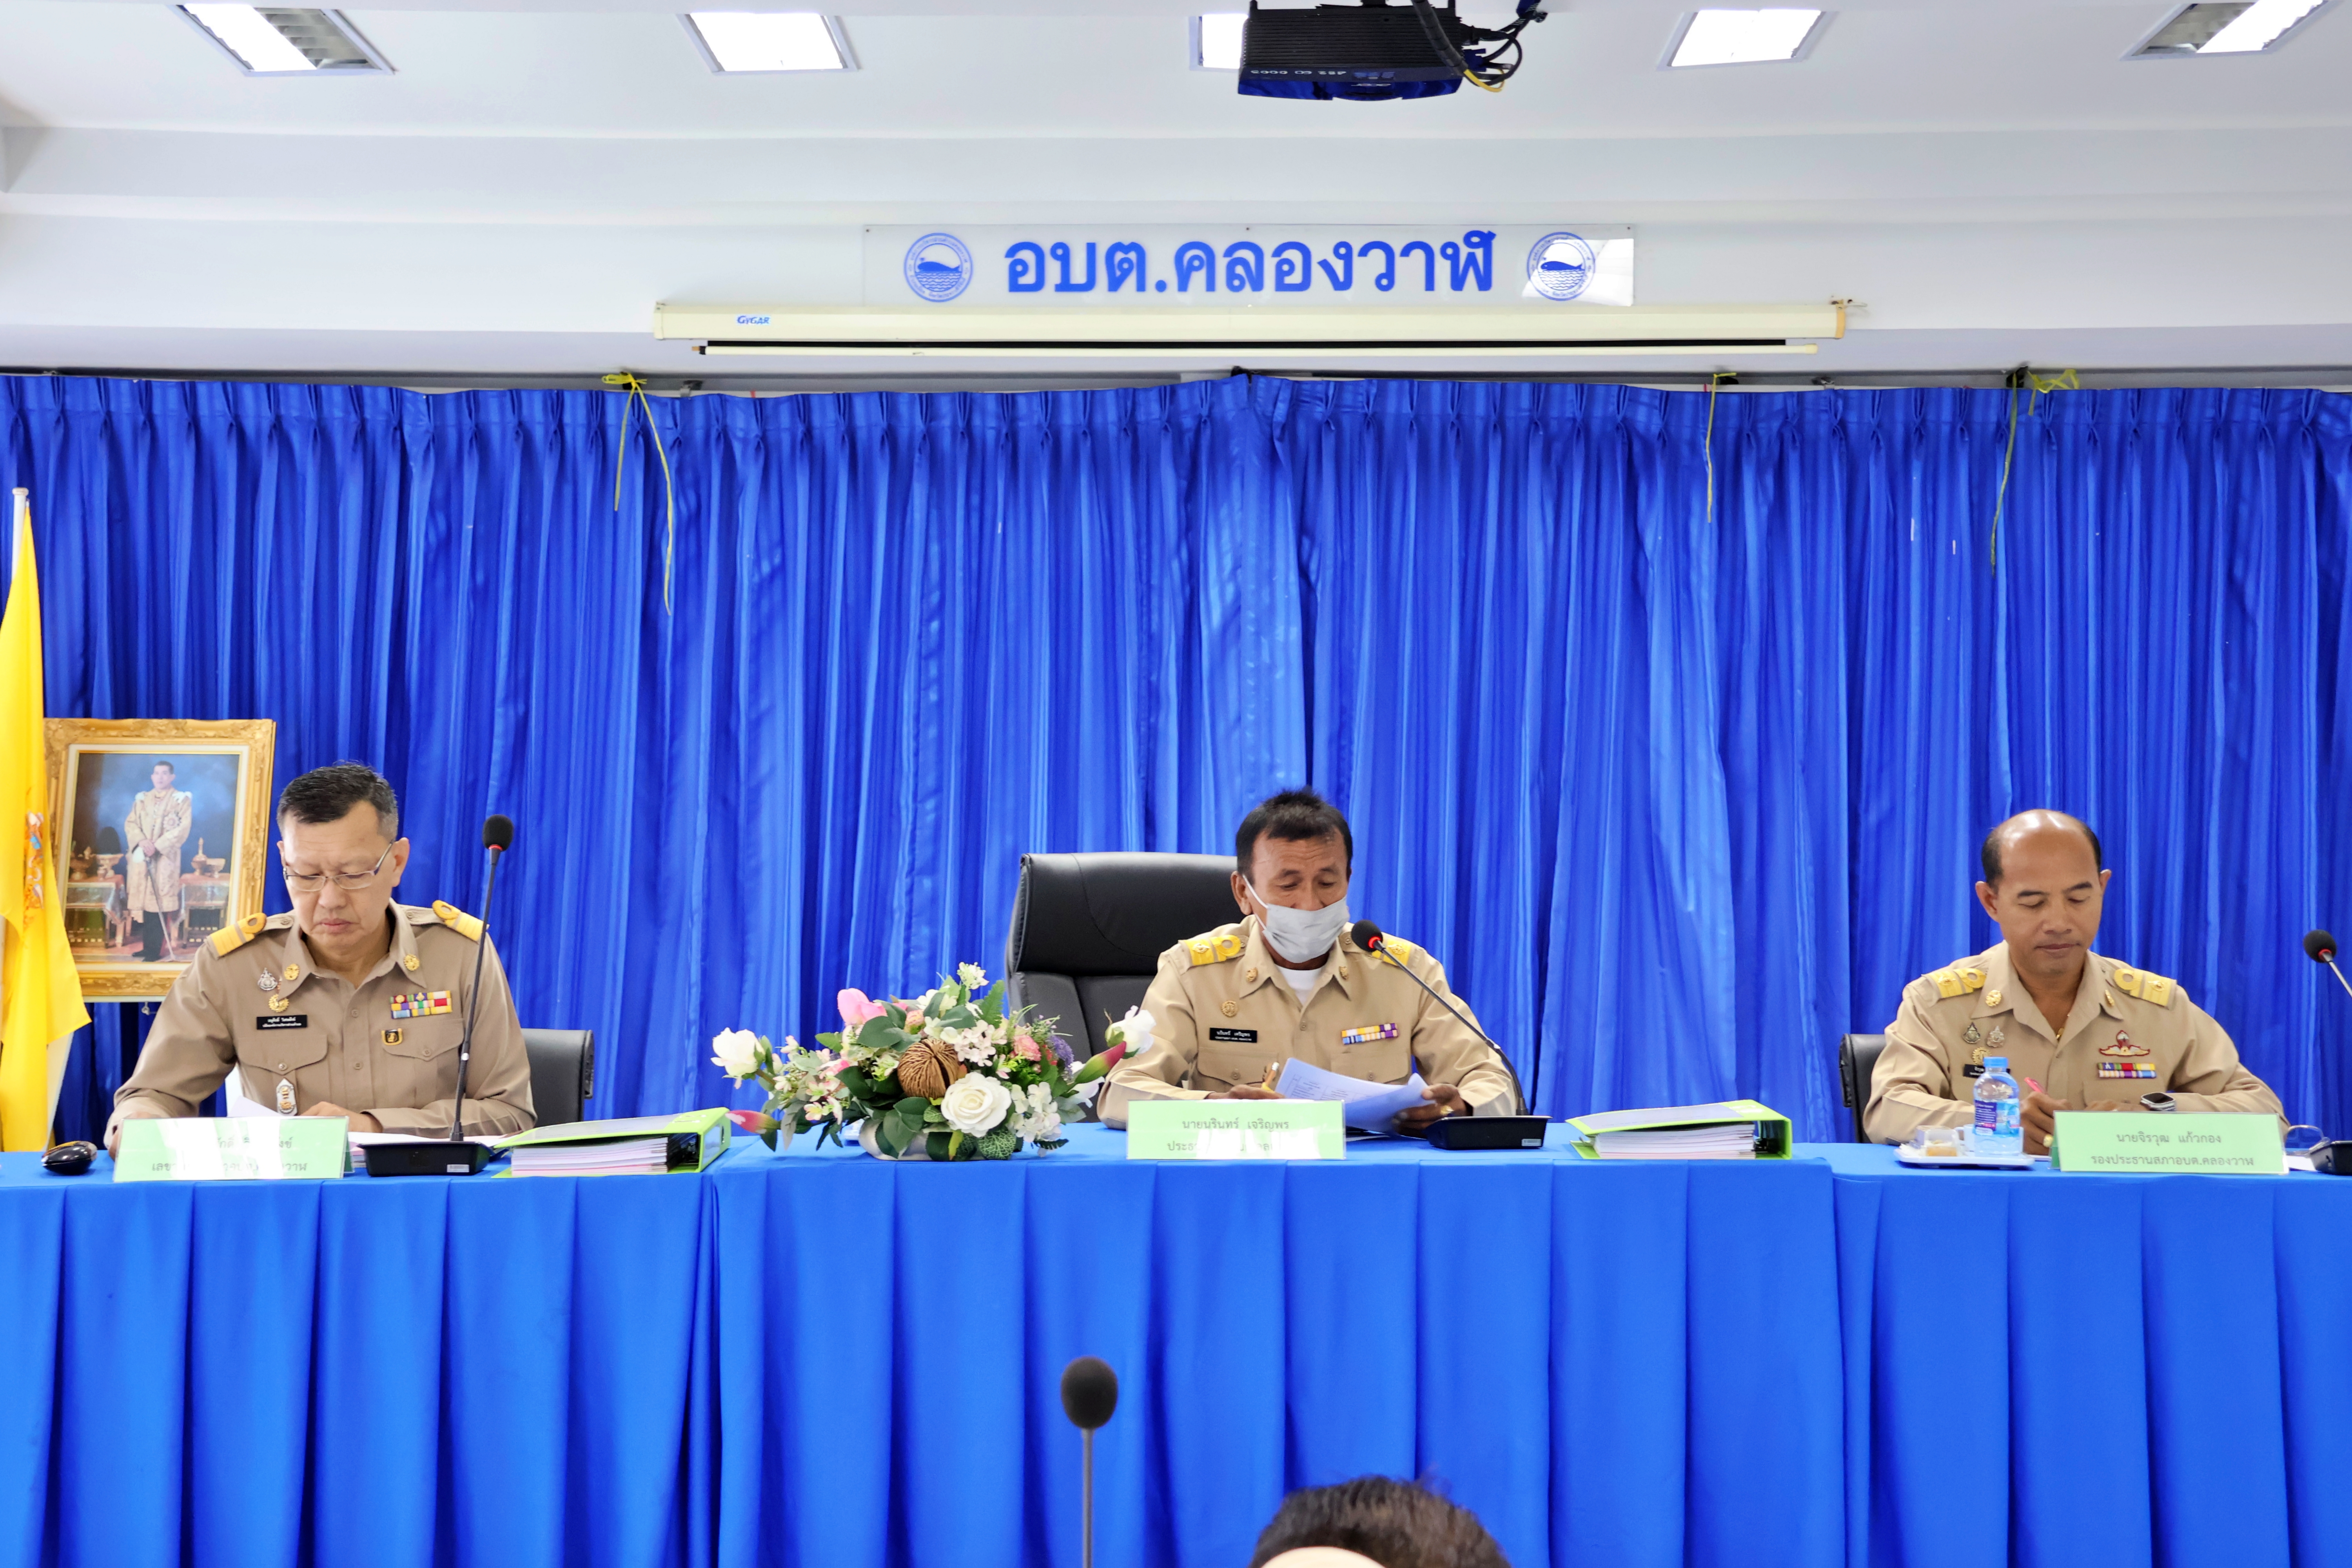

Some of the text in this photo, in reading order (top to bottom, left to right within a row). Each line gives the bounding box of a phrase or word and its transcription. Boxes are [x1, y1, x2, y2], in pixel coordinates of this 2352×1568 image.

[1004, 230, 1497, 293] อบต.คลองวาฬ
[1182, 1117, 1289, 1132] นายนรินทร์ เจริญพร
[2178, 1131, 2221, 1143] แก้วกอง
[2090, 1154, 2254, 1166] รองประธานสภาอบต.คลองวาฬ
